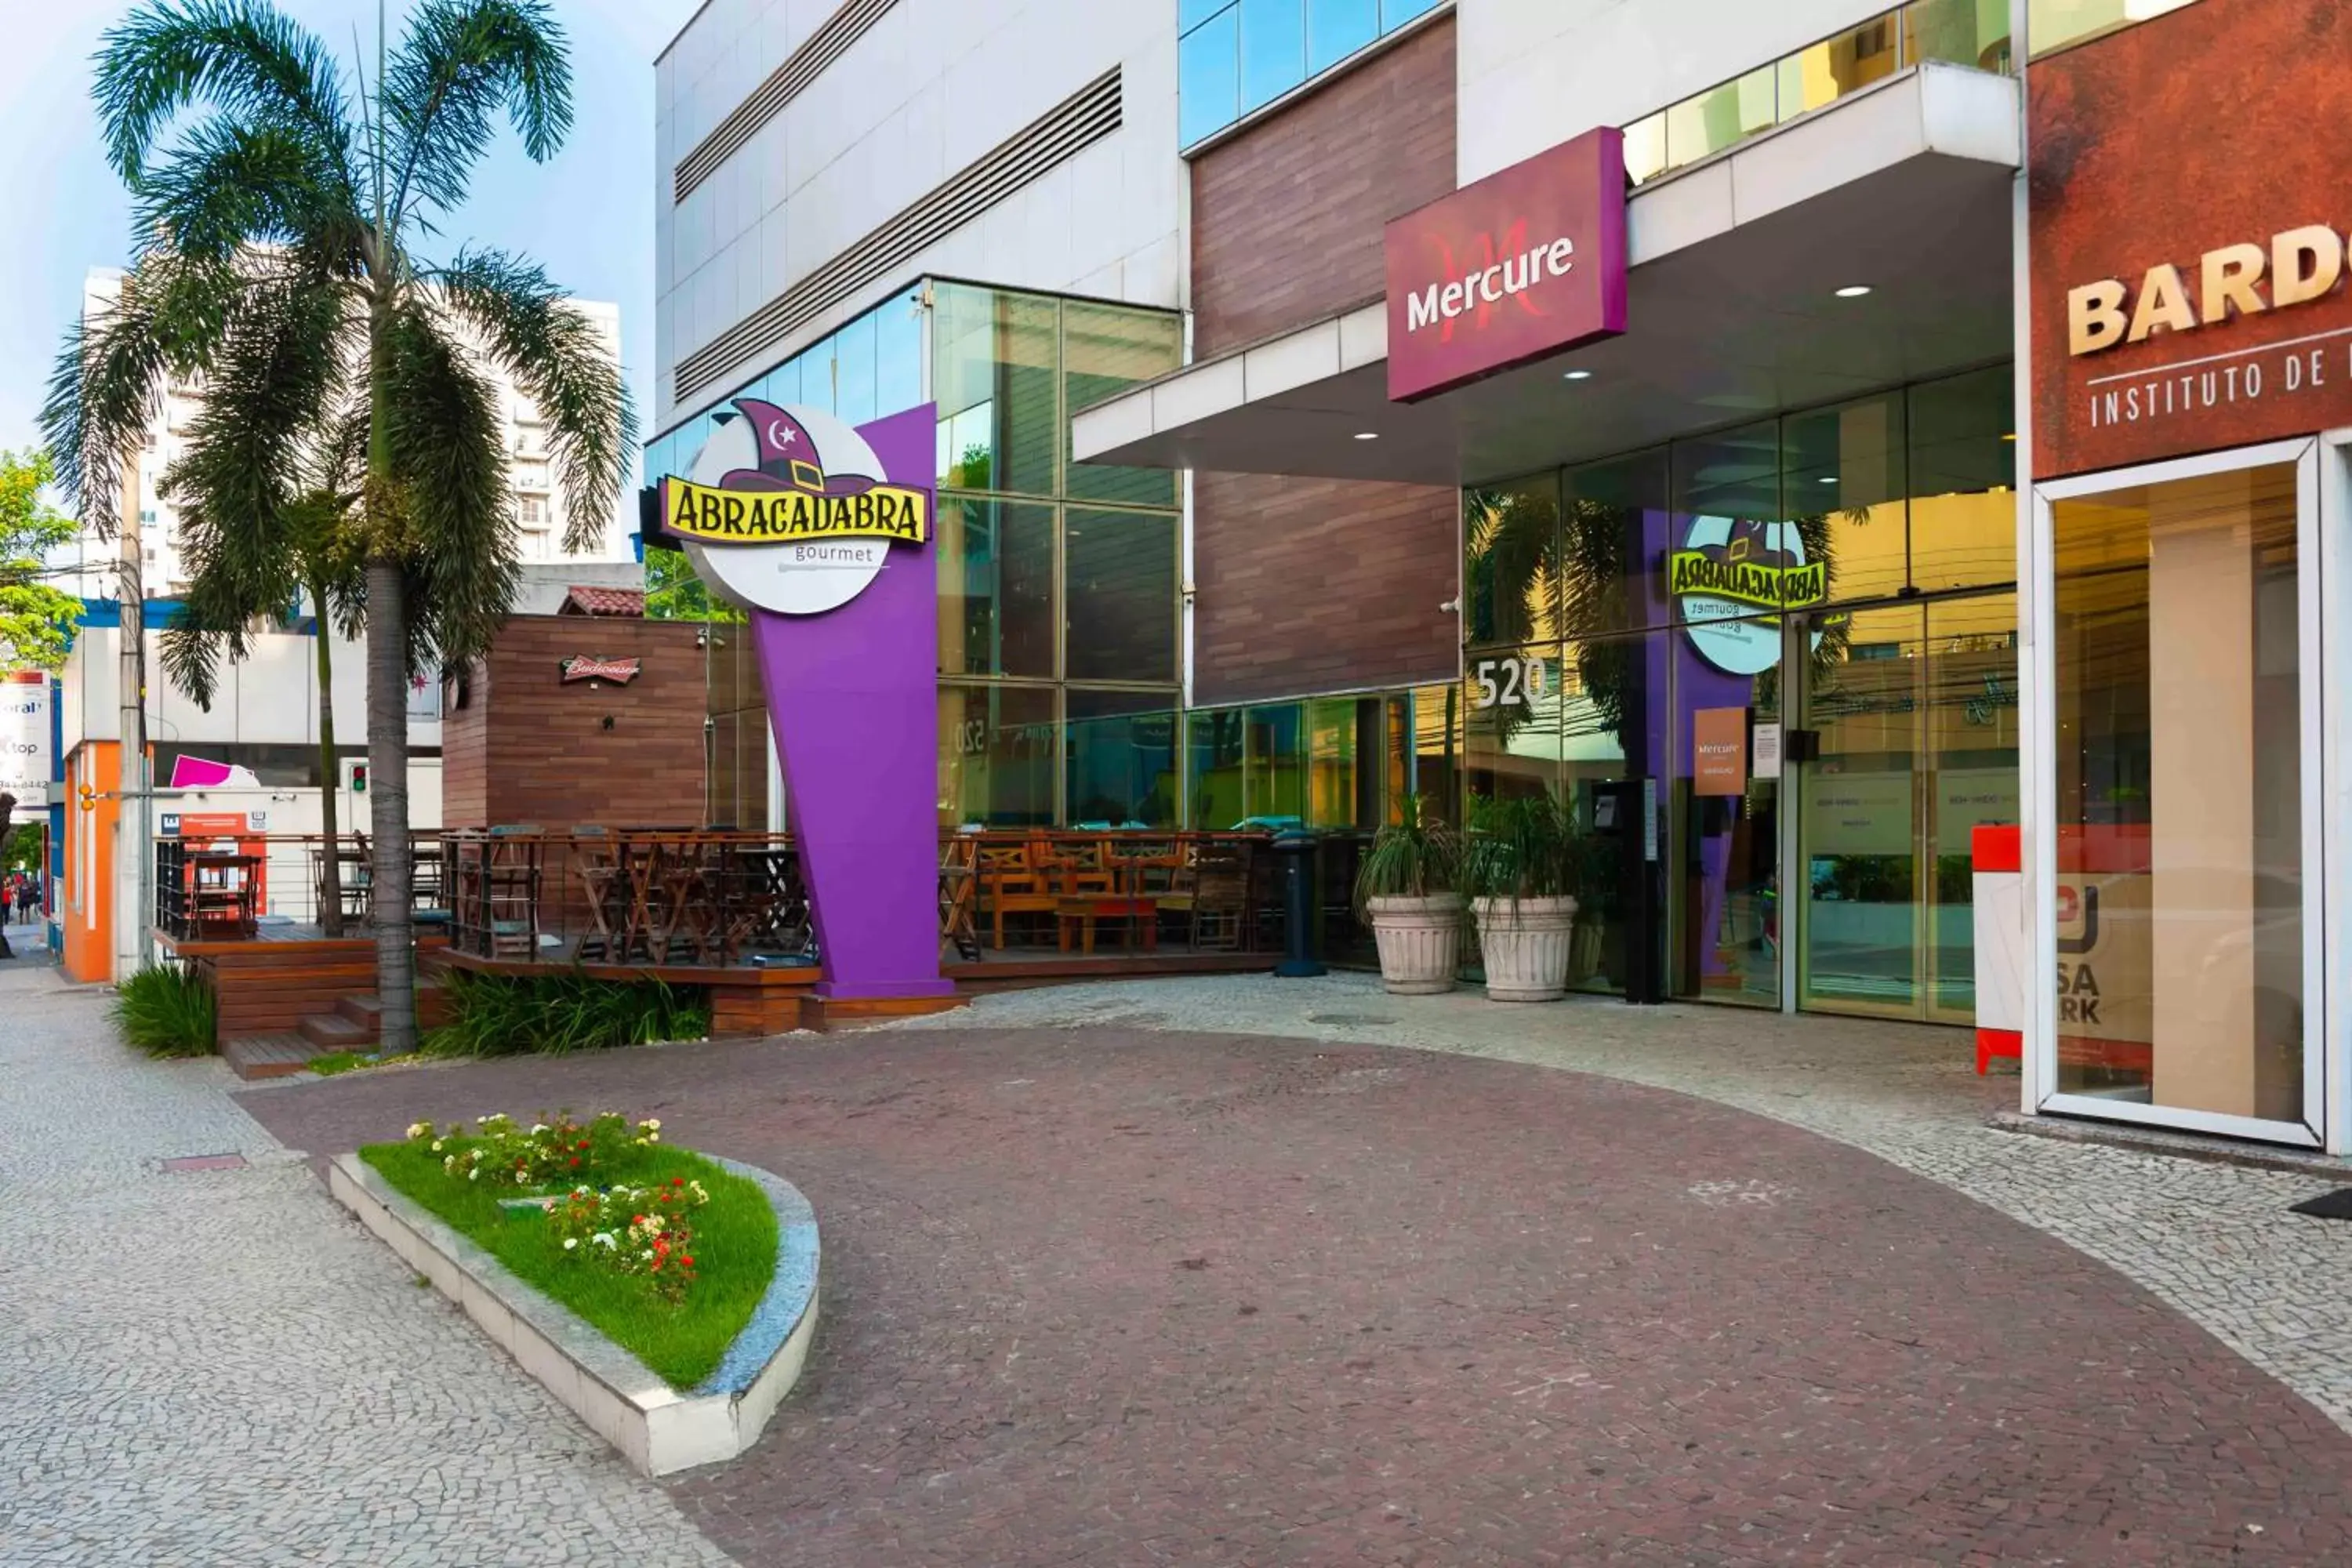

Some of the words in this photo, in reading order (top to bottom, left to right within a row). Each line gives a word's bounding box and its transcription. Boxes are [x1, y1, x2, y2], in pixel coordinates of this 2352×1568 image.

[1407, 237, 1573, 332] Mercure
[2068, 224, 2352, 356] BARD
[2091, 363, 2263, 427] INSTITUTO
[2285, 350, 2325, 391] DE
[674, 485, 918, 539] ABRACADABRA
[795, 546, 873, 563] gourmet
[1478, 659, 1545, 708] 520
